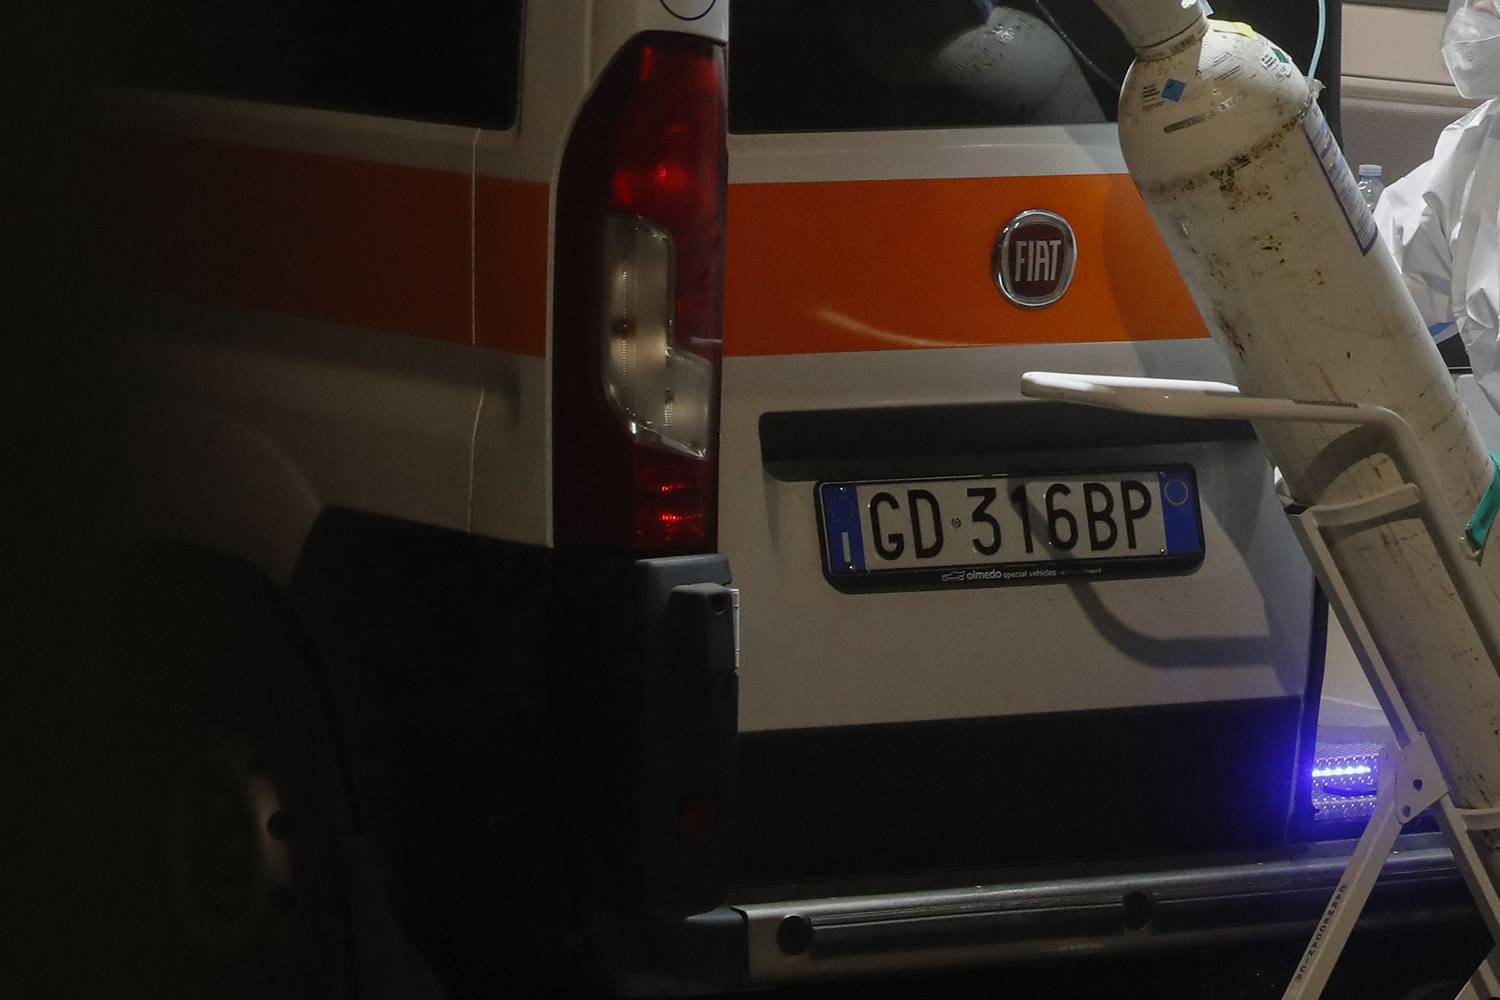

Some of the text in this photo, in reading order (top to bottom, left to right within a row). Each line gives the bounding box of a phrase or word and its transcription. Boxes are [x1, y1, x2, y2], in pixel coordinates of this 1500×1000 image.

[1014, 240, 1062, 282] FIAT
[868, 480, 1152, 561] GD 316BP
[966, 569, 1002, 581] olmedo
